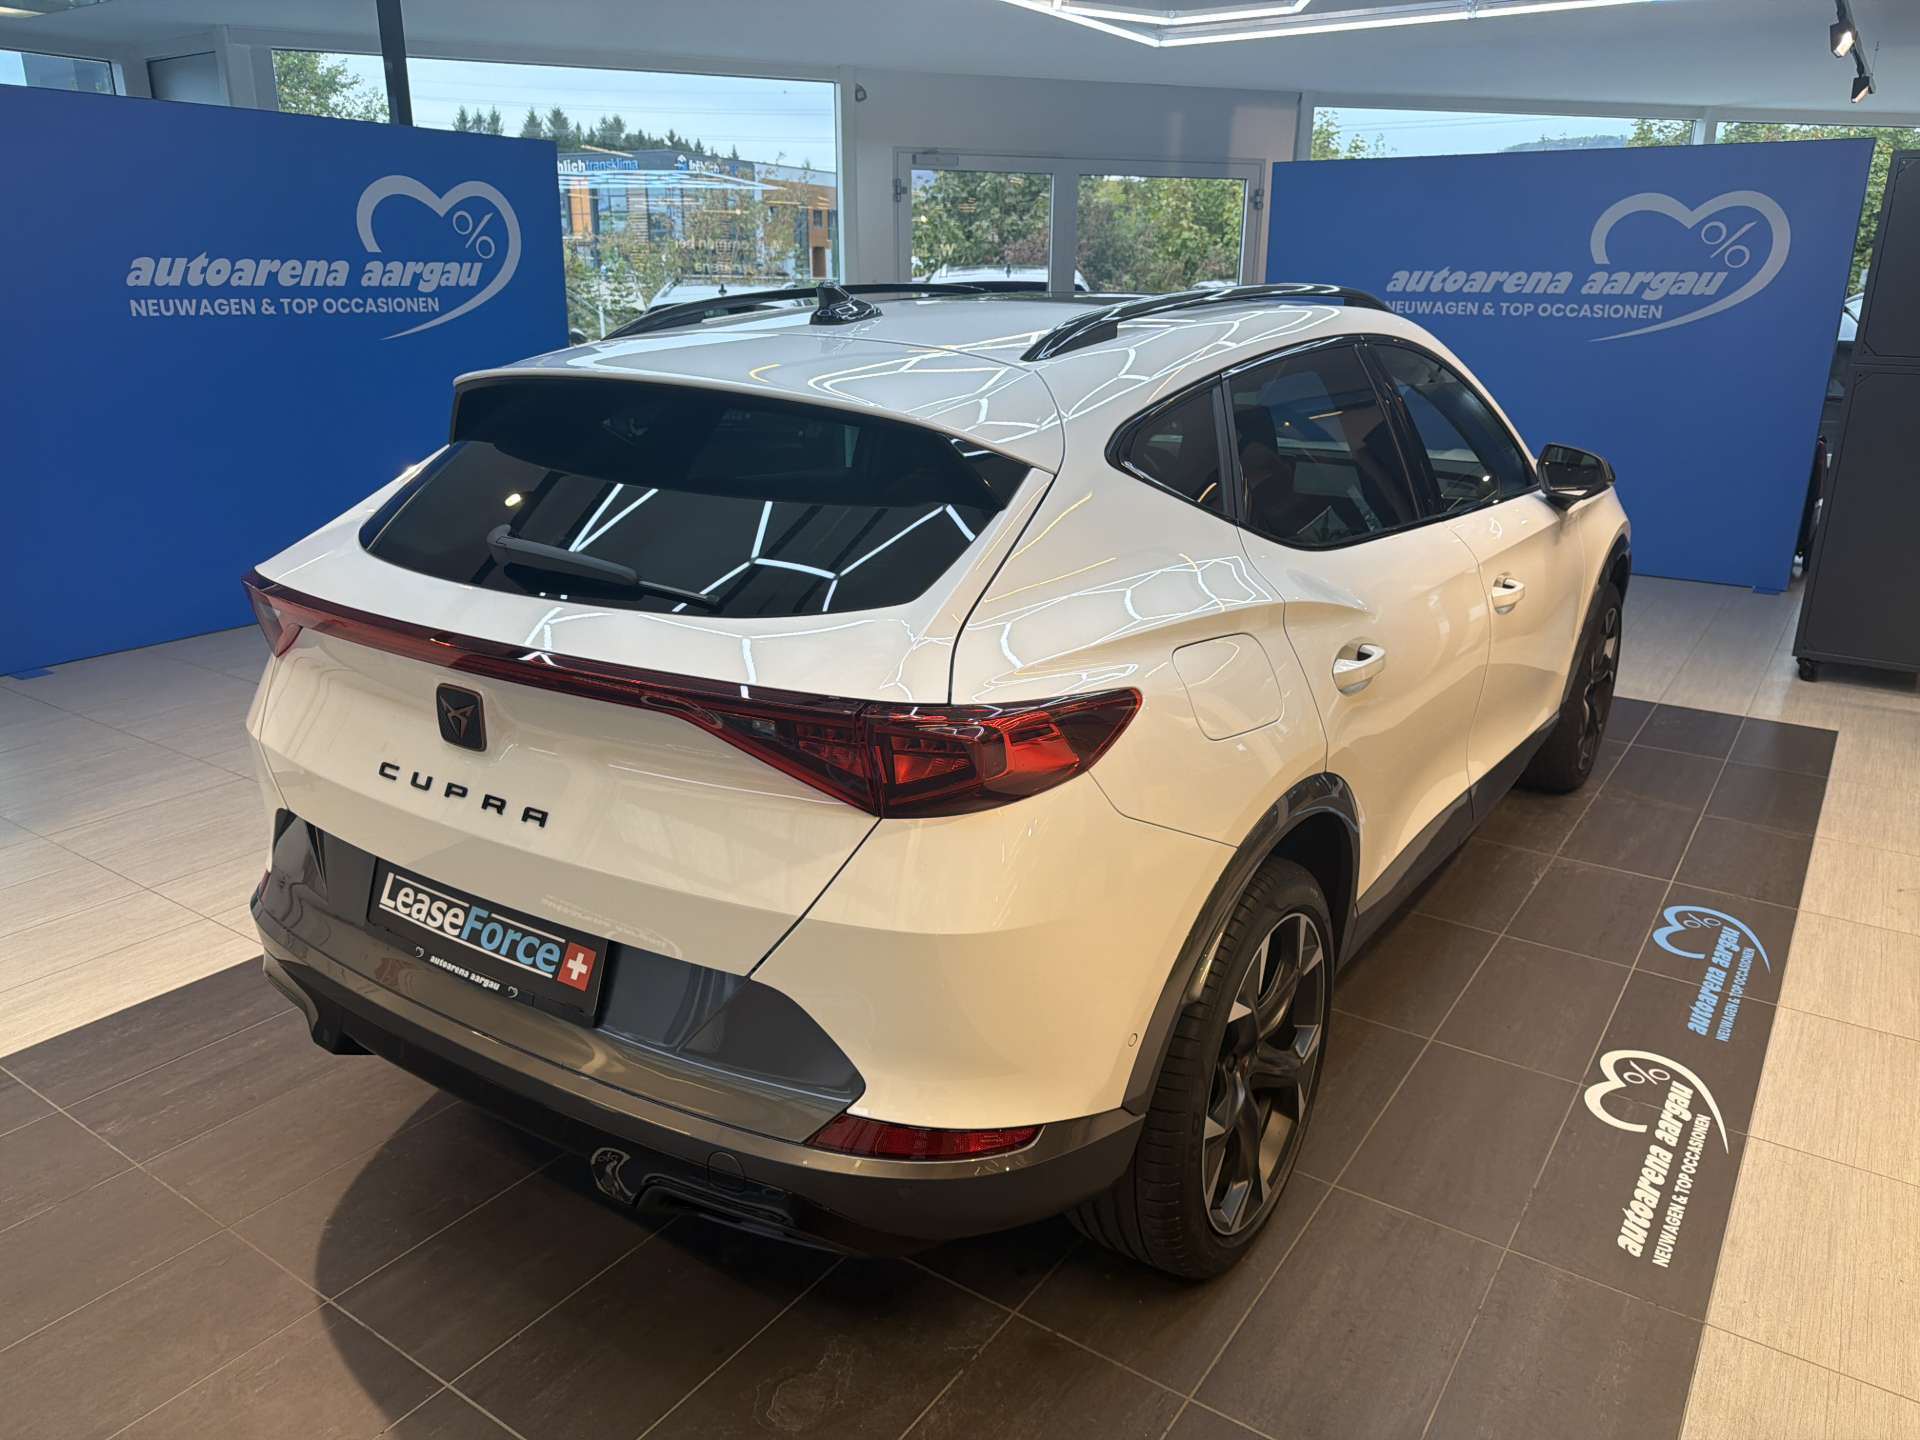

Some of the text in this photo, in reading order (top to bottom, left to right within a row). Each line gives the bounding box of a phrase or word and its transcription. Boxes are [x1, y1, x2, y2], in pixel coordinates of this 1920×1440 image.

[126, 252, 483, 293] autoarena aargau
[1386, 266, 1729, 301] autoarena aargau
[129, 297, 440, 317] NEUWAGEN & TOP OCCASIONEN
[1385, 301, 1663, 319] NEUWAGEN & TOP OCCASIONEN
[379, 762, 549, 828] CUPRA
[380, 872, 561, 974] LeaseForce
[430, 955, 501, 991] autoarena aargau
[1687, 926, 1741, 1036] autoarena aargau
[1715, 1001, 1740, 1042] NEUWAGEN
[1617, 1080, 1694, 1258] autoarena aargau
[1652, 1113, 1712, 1268] NEUWAGEN & TOP OCCASIONEN
